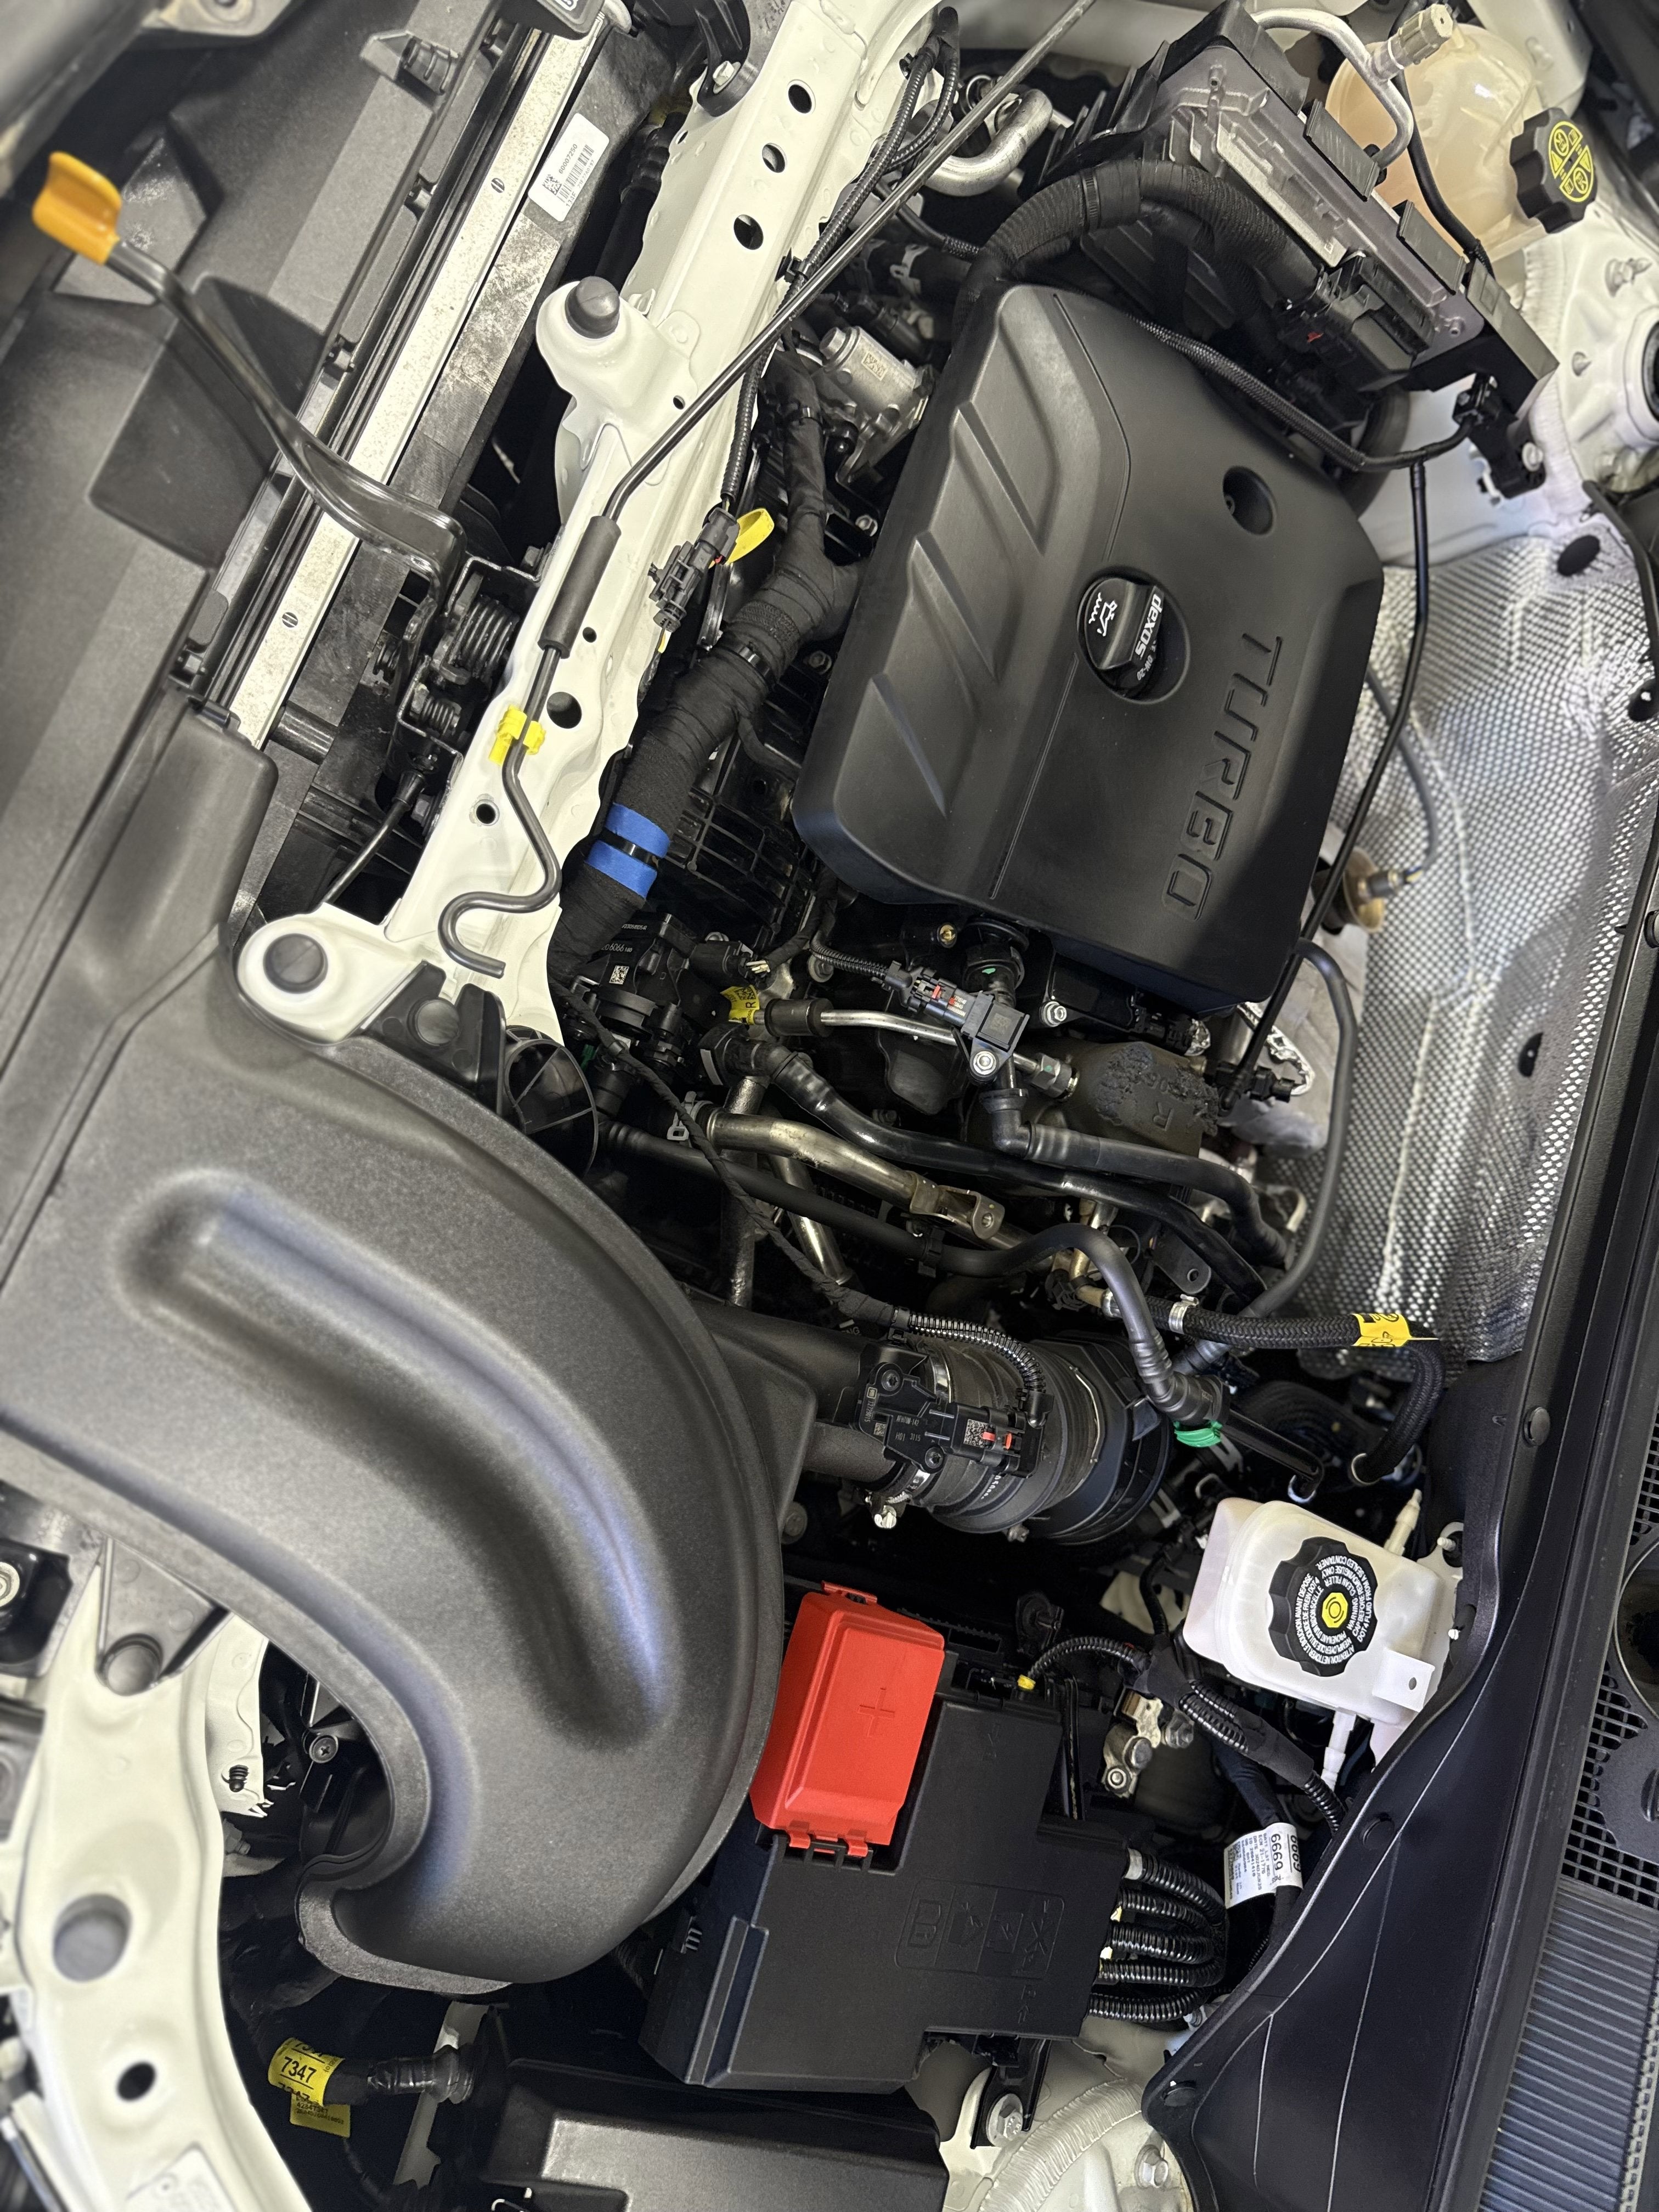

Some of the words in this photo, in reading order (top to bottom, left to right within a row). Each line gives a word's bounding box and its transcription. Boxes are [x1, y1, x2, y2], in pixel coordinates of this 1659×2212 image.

[558, 143, 578, 173] 60007250
[1135, 594, 1163, 659] dexos
[1163, 633, 1283, 921] TURBO
[1322, 1566, 1334, 1579] ONLY
[1335, 1566, 1345, 1575] USE
[1347, 1559, 1364, 1578] SEALED
[1308, 1580, 1317, 1594] DOT
[1324, 1576, 1342, 1587] FILLER
[1341, 1578, 1356, 1596] CLEAN
[1363, 1580, 1372, 1601] FROM
[1295, 1596, 1303, 1618] AVANT
[1303, 1592, 1312, 1611] FREIN
[1302, 1611, 1308, 1620] DE
[1310, 1609, 1318, 1627] BIDON
[1295, 1618, 1307, 1647] BOUCHON
[1303, 1620, 1314, 1641] LIQUIDE
[1352, 1622, 1361, 1637] CAP
[1357, 1627, 1367, 1642] DOT
[1304, 1643, 1311, 1653] LE
[1311, 1637, 1318, 1647] DU
[1270, 1833, 1283, 1870] 6669
[280, 2056, 317, 2083] 7347
